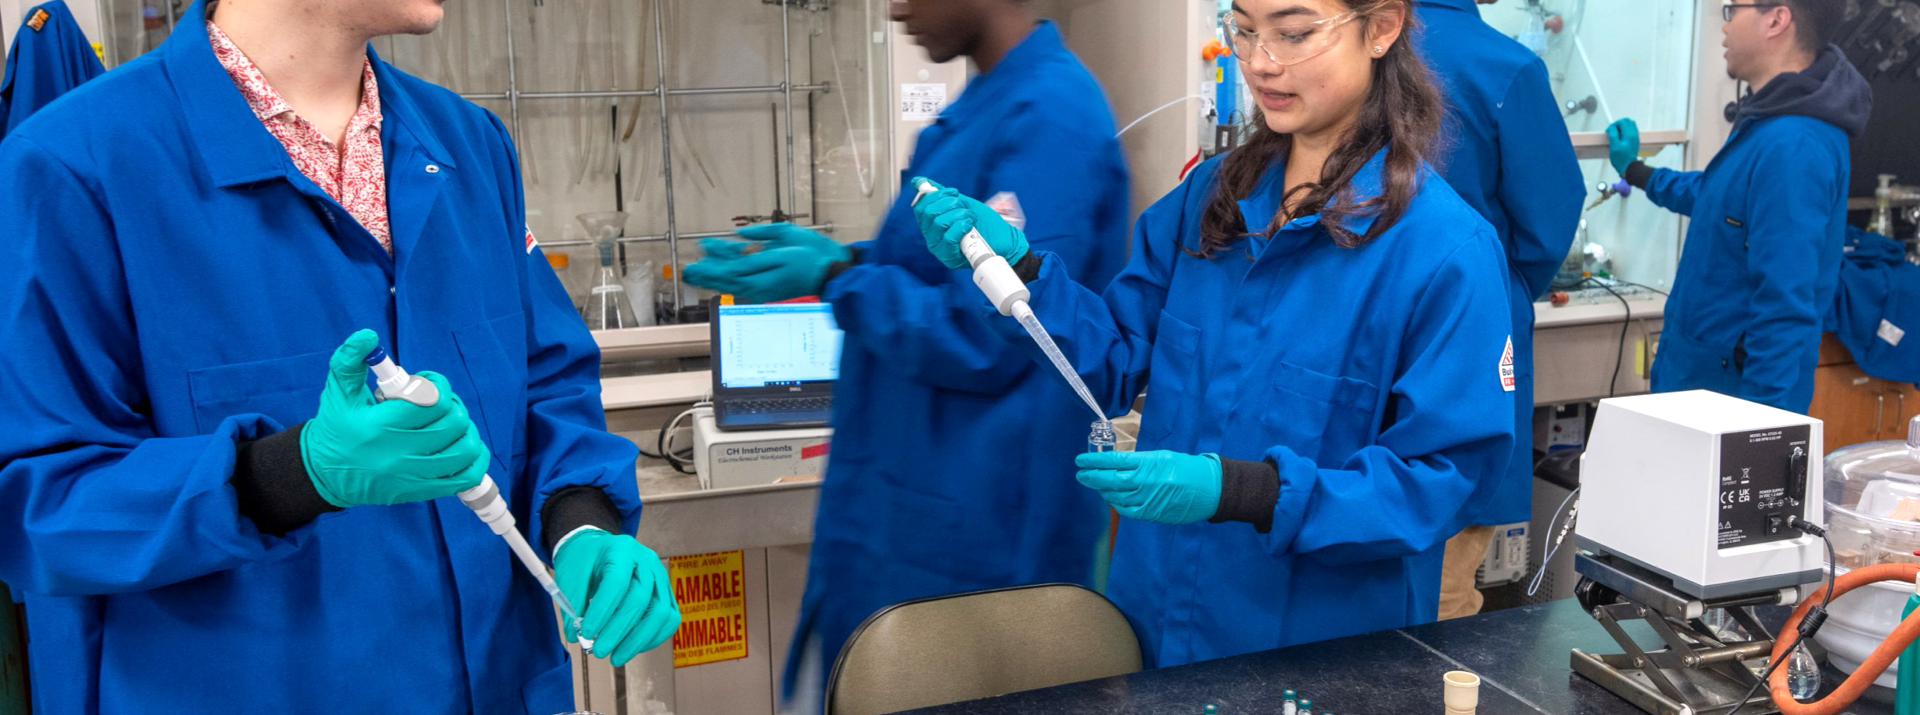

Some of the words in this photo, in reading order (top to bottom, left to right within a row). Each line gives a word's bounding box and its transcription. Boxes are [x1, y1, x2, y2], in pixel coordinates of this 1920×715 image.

[726, 447, 740, 456] CH
[742, 445, 792, 454] Instruments
[718, 455, 759, 464] Electrochemical
[678, 560, 699, 570] FIRE
[702, 557, 728, 566] AWAY
[720, 600, 741, 609] FUEGO
[688, 649, 704, 658] DES
[706, 643, 743, 655] FLAMMES
